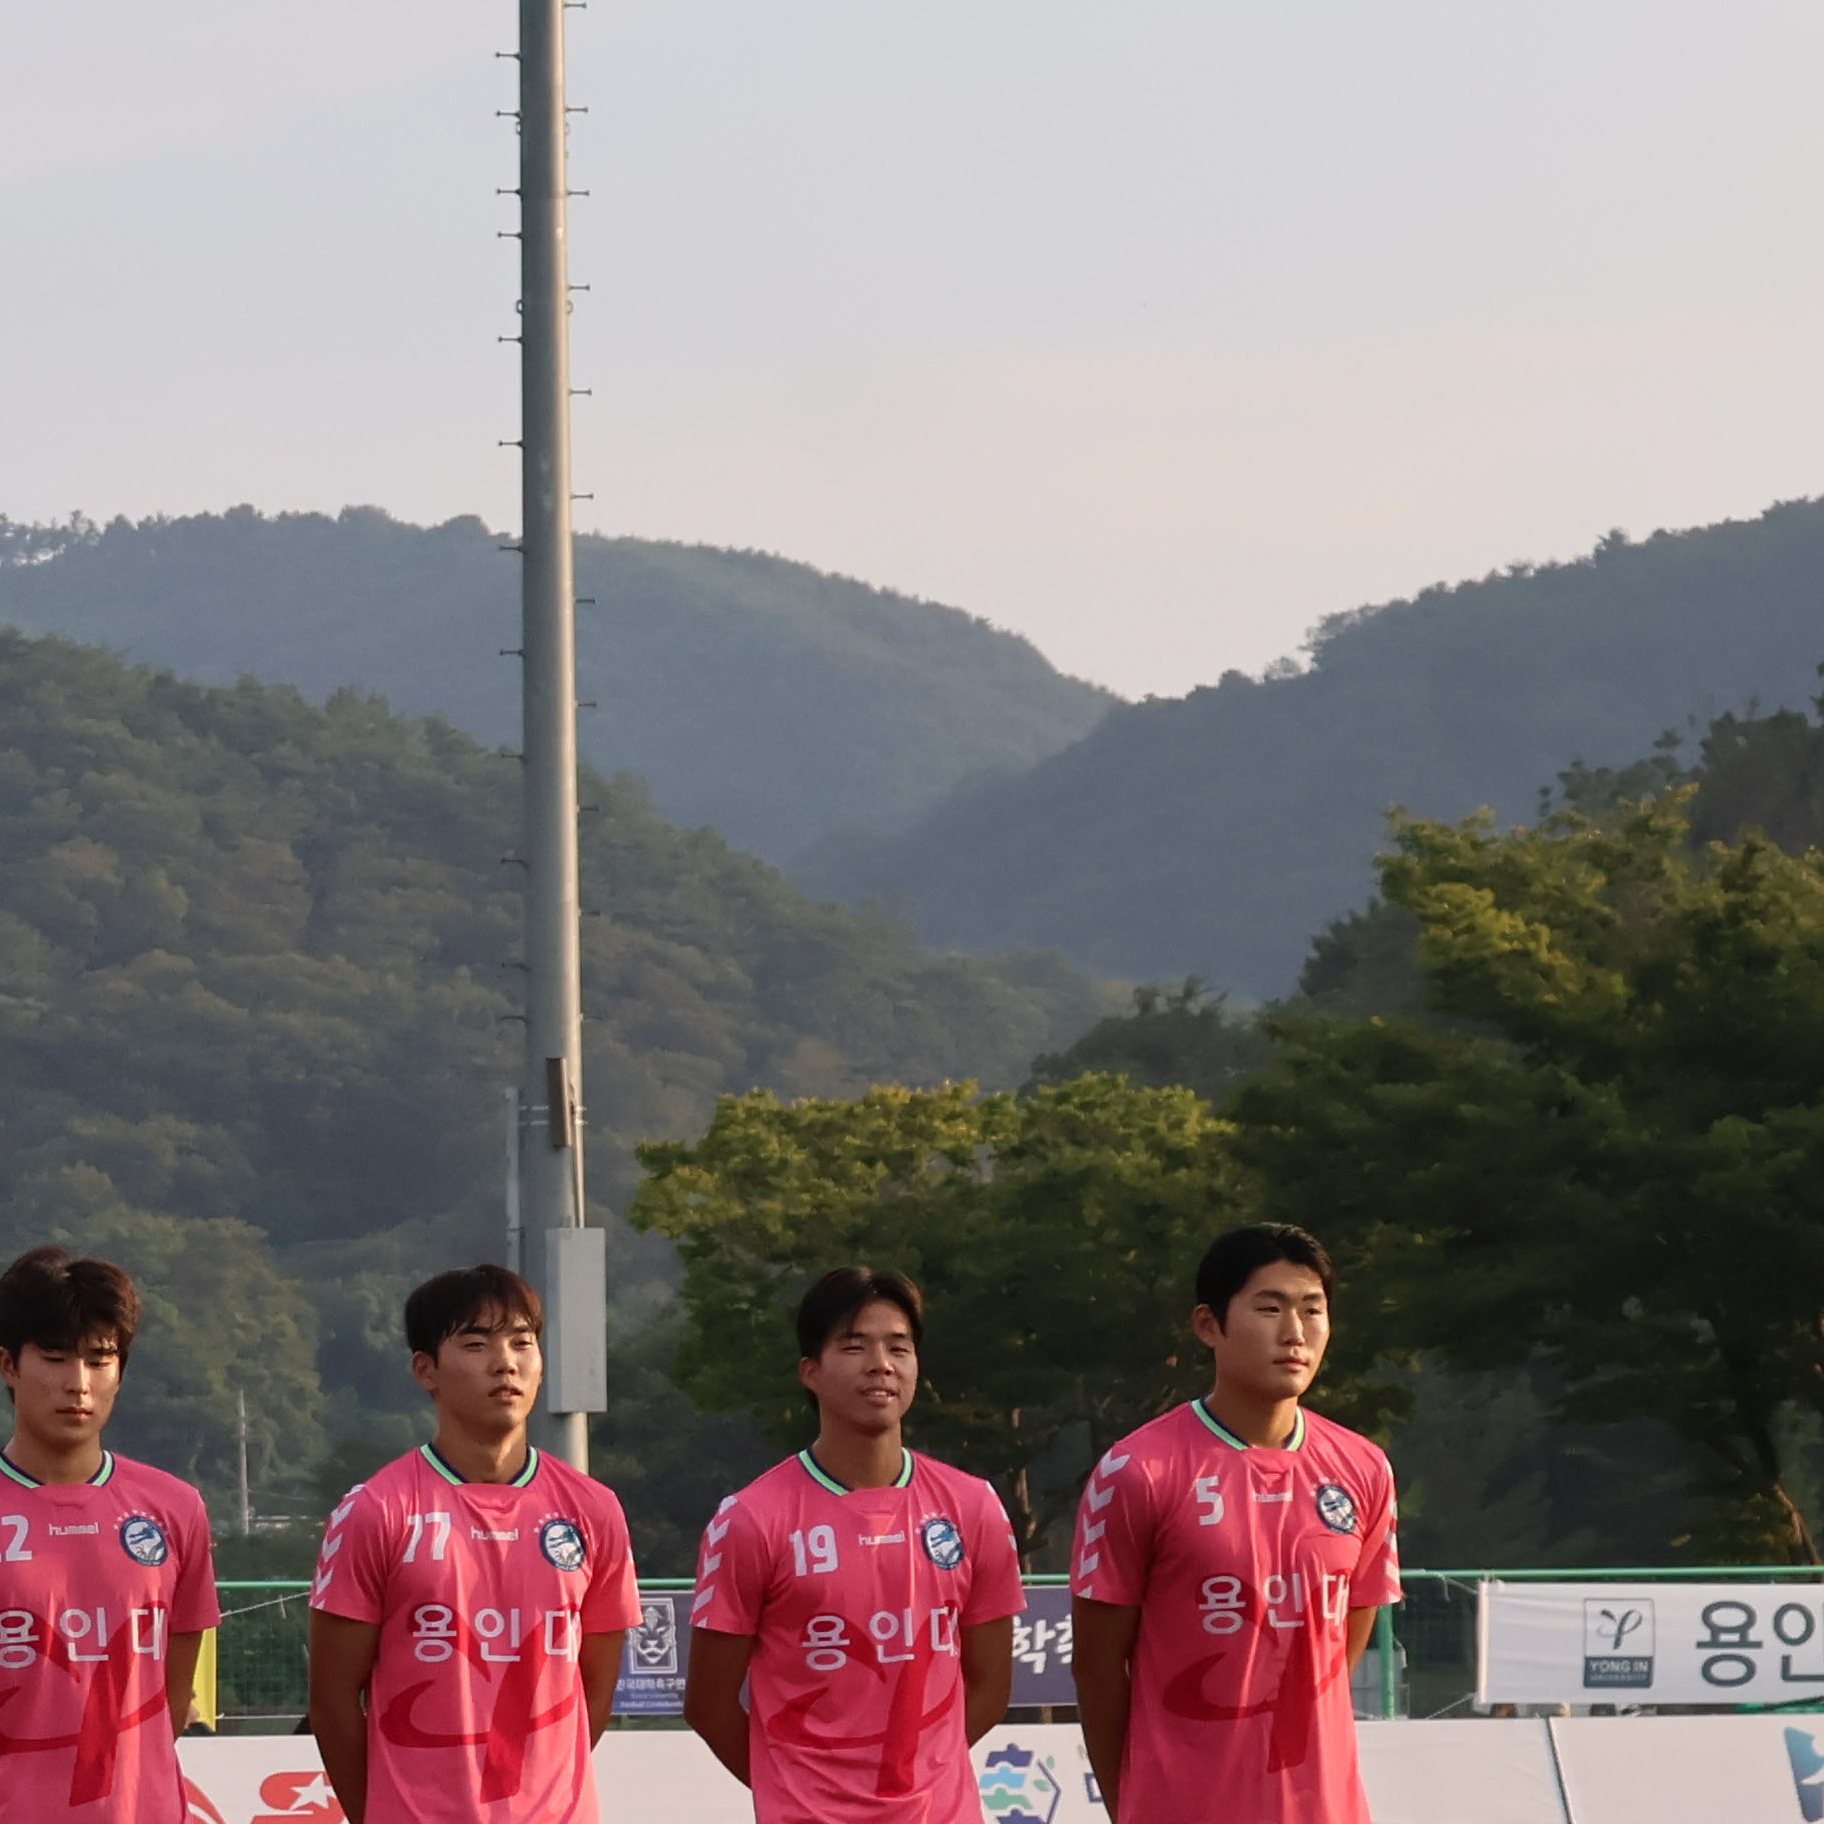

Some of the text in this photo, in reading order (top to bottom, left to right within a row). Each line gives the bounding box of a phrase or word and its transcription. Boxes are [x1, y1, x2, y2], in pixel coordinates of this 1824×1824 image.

[1196, 1475, 1224, 1526] 5
[48, 1522, 99, 1536] hummel
[402, 1512, 450, 1563] 77
[470, 1527, 519, 1541] hummel
[789, 1524, 839, 1577] 19
[1199, 1573, 1350, 1635] 용인대
